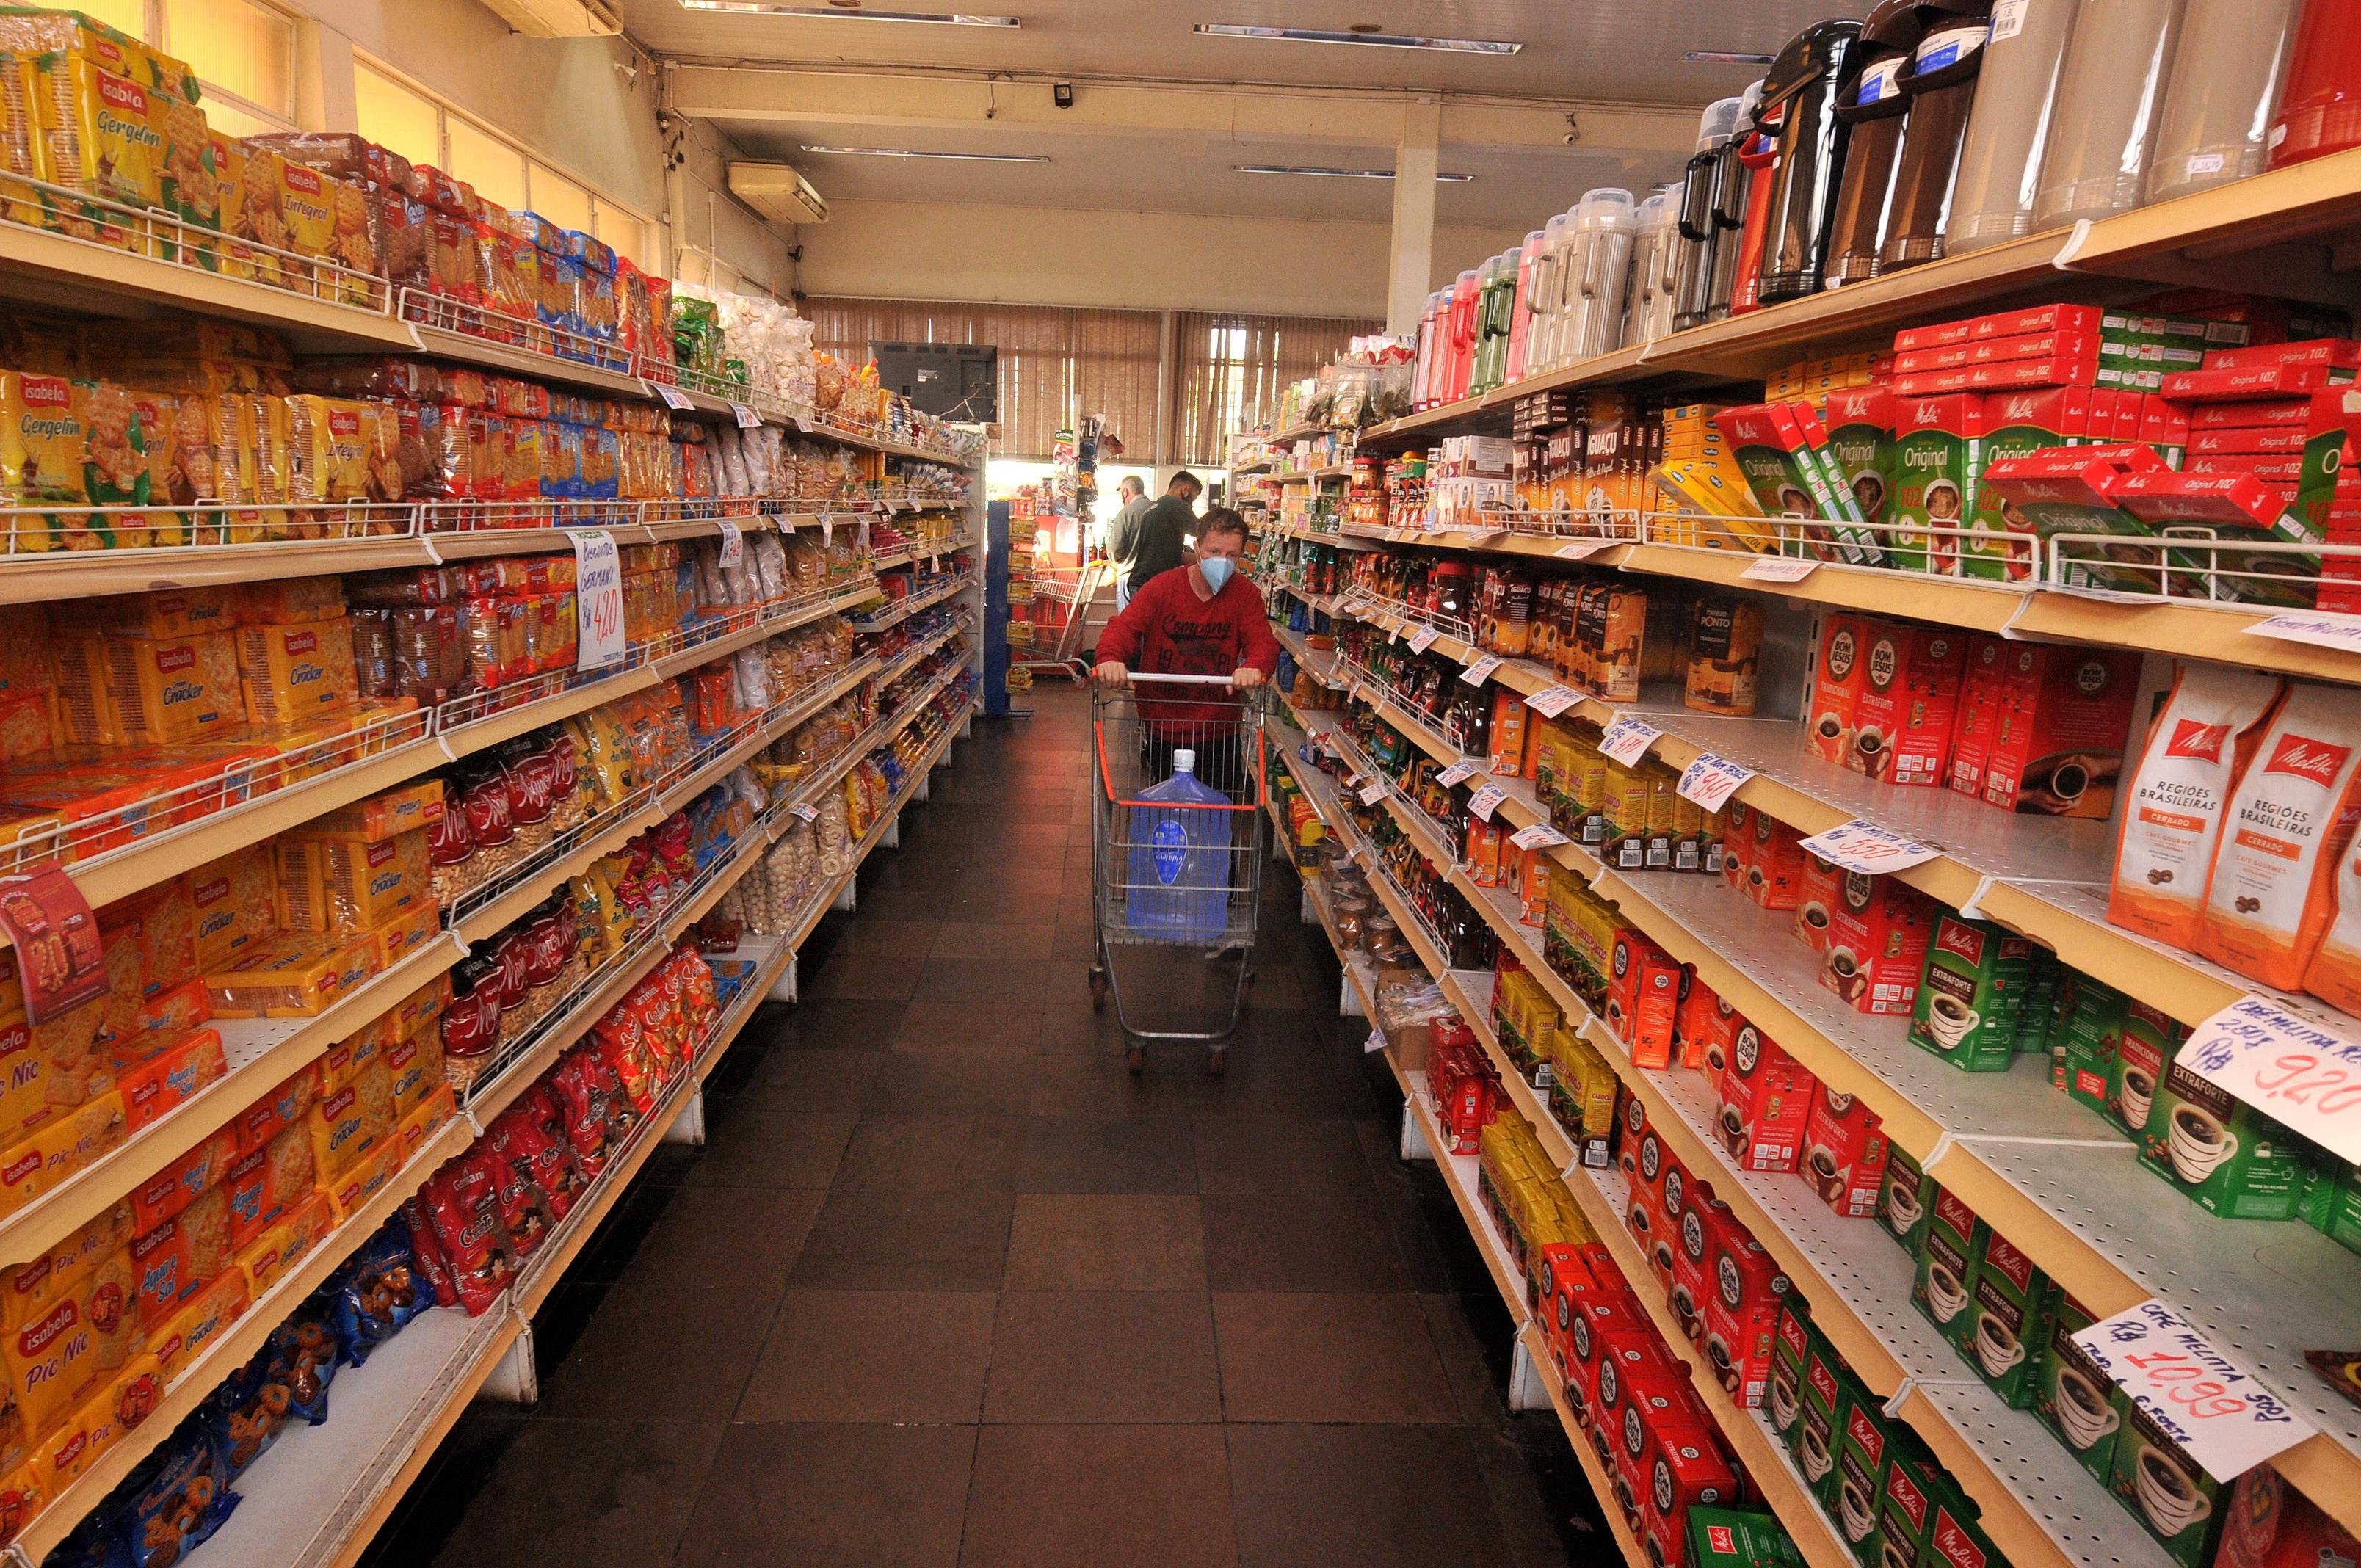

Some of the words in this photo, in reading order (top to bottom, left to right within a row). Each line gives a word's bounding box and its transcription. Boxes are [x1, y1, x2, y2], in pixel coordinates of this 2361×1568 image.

[287, 168, 318, 190] isabela
[283, 194, 329, 222] Integral
[2039, 313, 2053, 323] 102
[2039, 339, 2053, 349] 102
[2279, 352, 2307, 363] Original
[2310, 347, 2328, 359] 102
[2035, 365, 2050, 375] 102
[2230, 375, 2257, 385] Original
[2259, 371, 2276, 382] 102
[25, 383, 65, 402] isabela
[21, 414, 80, 440] Gergelim
[331, 416, 359, 435] isabela
[1550, 437, 1570, 459] IGUAÇU
[1588, 432, 1617, 456] IGUAÇU
[1834, 440, 1876, 468] Original
[2260, 438, 2287, 448] Original
[1745, 458, 1785, 480] Original
[1904, 445, 1948, 471] Original
[2072, 461, 2088, 471] 102
[2254, 464, 2281, 475] Original
[2284, 463, 2302, 473] 102
[2185, 480, 2213, 489] Original
[2215, 479, 2235, 489] 102
[1901, 487, 1922, 508] 102
[1701, 614, 1730, 628] PONTO
[288, 636, 314, 650] isabela
[1835, 641, 1851, 653] BOM
[160, 652, 192, 668] isabela
[1832, 651, 1851, 664] JESUS
[1872, 661, 1893, 674] JESUS
[1875, 650, 1891, 661] BOM
[291, 666, 324, 686] Cracker
[2079, 667, 2103, 677] BOM
[164, 683, 203, 706] Cracker
[2280, 744, 2336, 776] Melitta
[2140, 788, 2217, 811] BRASILEIRAS
[2157, 781, 2211, 799] REGIÕES
[2151, 813, 2190, 827] CERRADO
[2240, 809, 2313, 837] BRASILEIRAS
[2254, 799, 2308, 823] REGIÕES
[370, 846, 394, 863] isabela
[1839, 838, 1900, 858] 5,50
[2247, 837, 2283, 852] CERRADO
[370, 872, 402, 896] Cracker
[1847, 879, 1869, 898] JESUS
[200, 911, 235, 938] Cracker
[1836, 909, 1868, 937] EXTRAFORTE
[1943, 927, 1974, 954] Melitta
[340, 968, 364, 990] Cracker
[1932, 968, 1973, 992] EXTRAFORTE
[394, 1043, 416, 1064] isabela
[1741, 1033, 1758, 1050] BOM
[2125, 1034, 2161, 1067] TRADICIONAL
[1737, 1045, 1755, 1065] JESUS
[12, 1059, 40, 1092] Nic
[395, 1067, 423, 1096] Cracker
[1727, 1070, 1752, 1099] EXTRAFORTE
[2173, 1065, 2229, 1105] EXTRAFORTE
[135, 1083, 158, 1102] isabela
[326, 1091, 353, 1117] isabela
[330, 1117, 362, 1151] Cracker
[1816, 1108, 1849, 1143] EXTRAFORTE
[46, 1150, 71, 1171] Pic
[74, 1136, 93, 1154] Nic
[231, 1150, 263, 1179] isabela
[7, 1156, 39, 1181] isabela
[1892, 1158, 1918, 1186] EXTRAFORTE
[1940, 1198, 1966, 1230] Melitta
[136, 1222, 173, 1257] isabela
[1931, 1234, 1963, 1269] EXTRAFORTE
[55, 1252, 76, 1274] Pic
[80, 1234, 99, 1257] Nic
[1992, 1244, 2023, 1280] Melitta
[450, 1263, 465, 1295] Germani
[1678, 1249, 1702, 1285] EXTRAFORTE
[1981, 1282, 2019, 1320] EXTRAFORTE
[1711, 1296, 1740, 1333] EXTRAFORTE
[26, 1309, 72, 1351] isabela
[185, 1315, 218, 1351] Cracker
[1785, 1322, 1801, 1351] Melitta
[25, 1358, 59, 1393] Pic
[63, 1332, 89, 1367] Nic
[2175, 1335, 2246, 1383] MELITTA
[1814, 1368, 1832, 1399] Melitta
[90, 1424, 110, 1448] Pic
[1854, 1420, 1876, 1455] Melitta
[59, 1434, 85, 1465] isabela
[1665, 1441, 1684, 1468] EXTRAFORTE
[1844, 1451, 1874, 1493] EXTRAFORTE
[1893, 1479, 1919, 1517] Melitta
[1884, 1514, 1915, 1558] EXTRAFORTE
